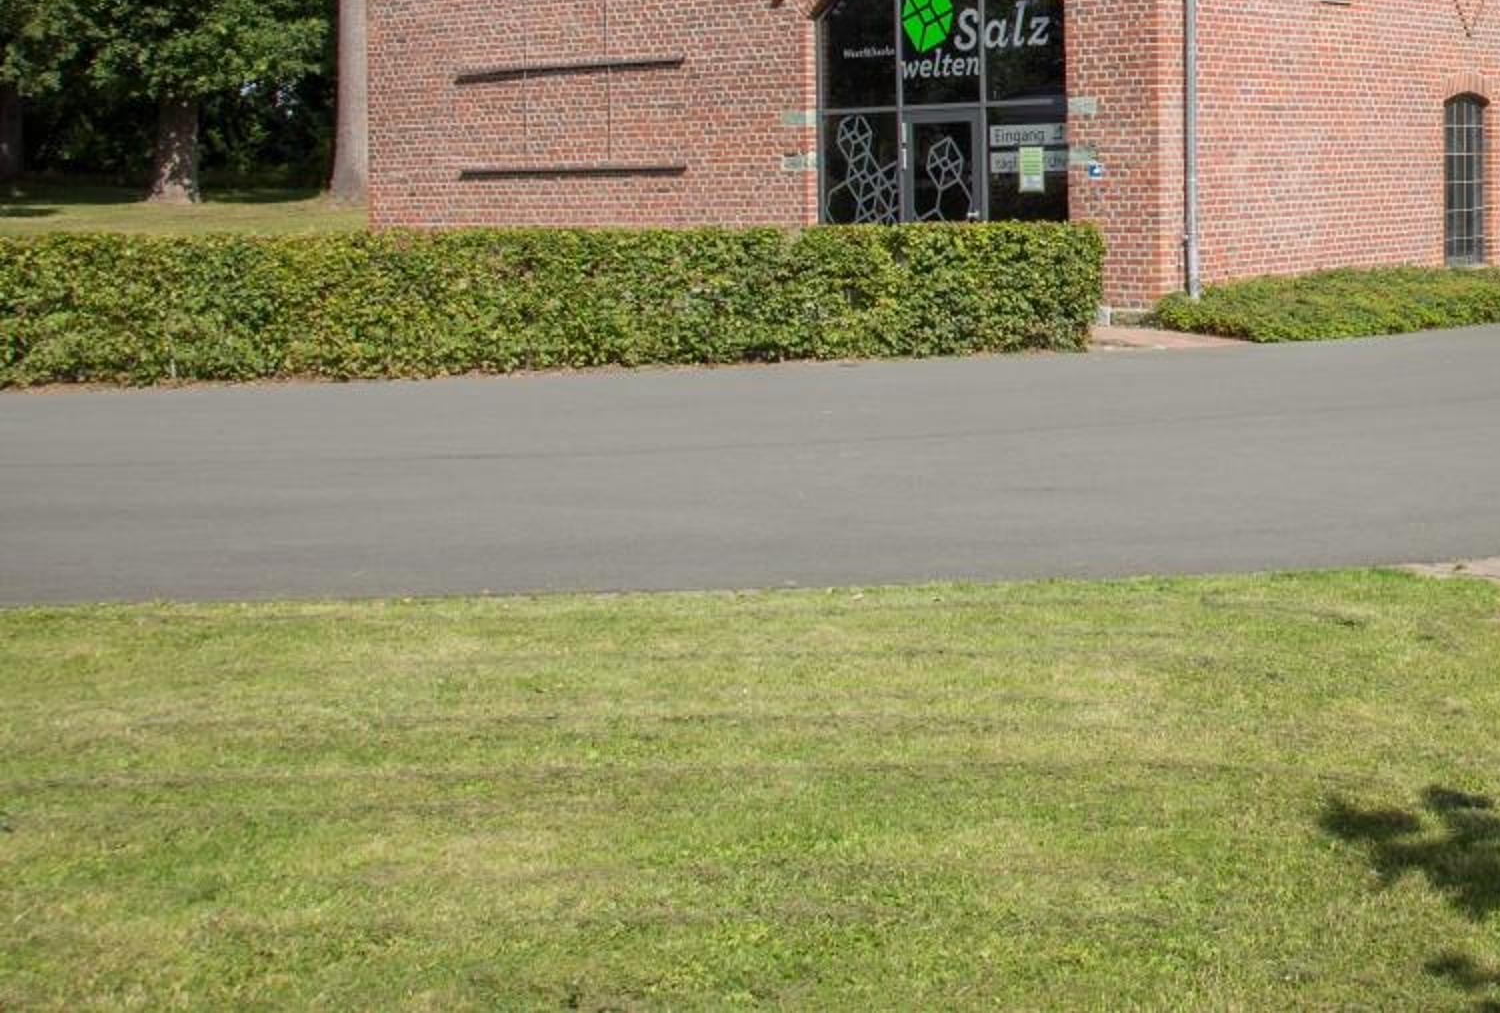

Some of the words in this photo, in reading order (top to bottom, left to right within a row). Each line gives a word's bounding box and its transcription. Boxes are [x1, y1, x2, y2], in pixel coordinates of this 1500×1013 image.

[954, 0, 1050, 50] Salz
[901, 49, 980, 79] welten
[994, 129, 1045, 145] Eingang
